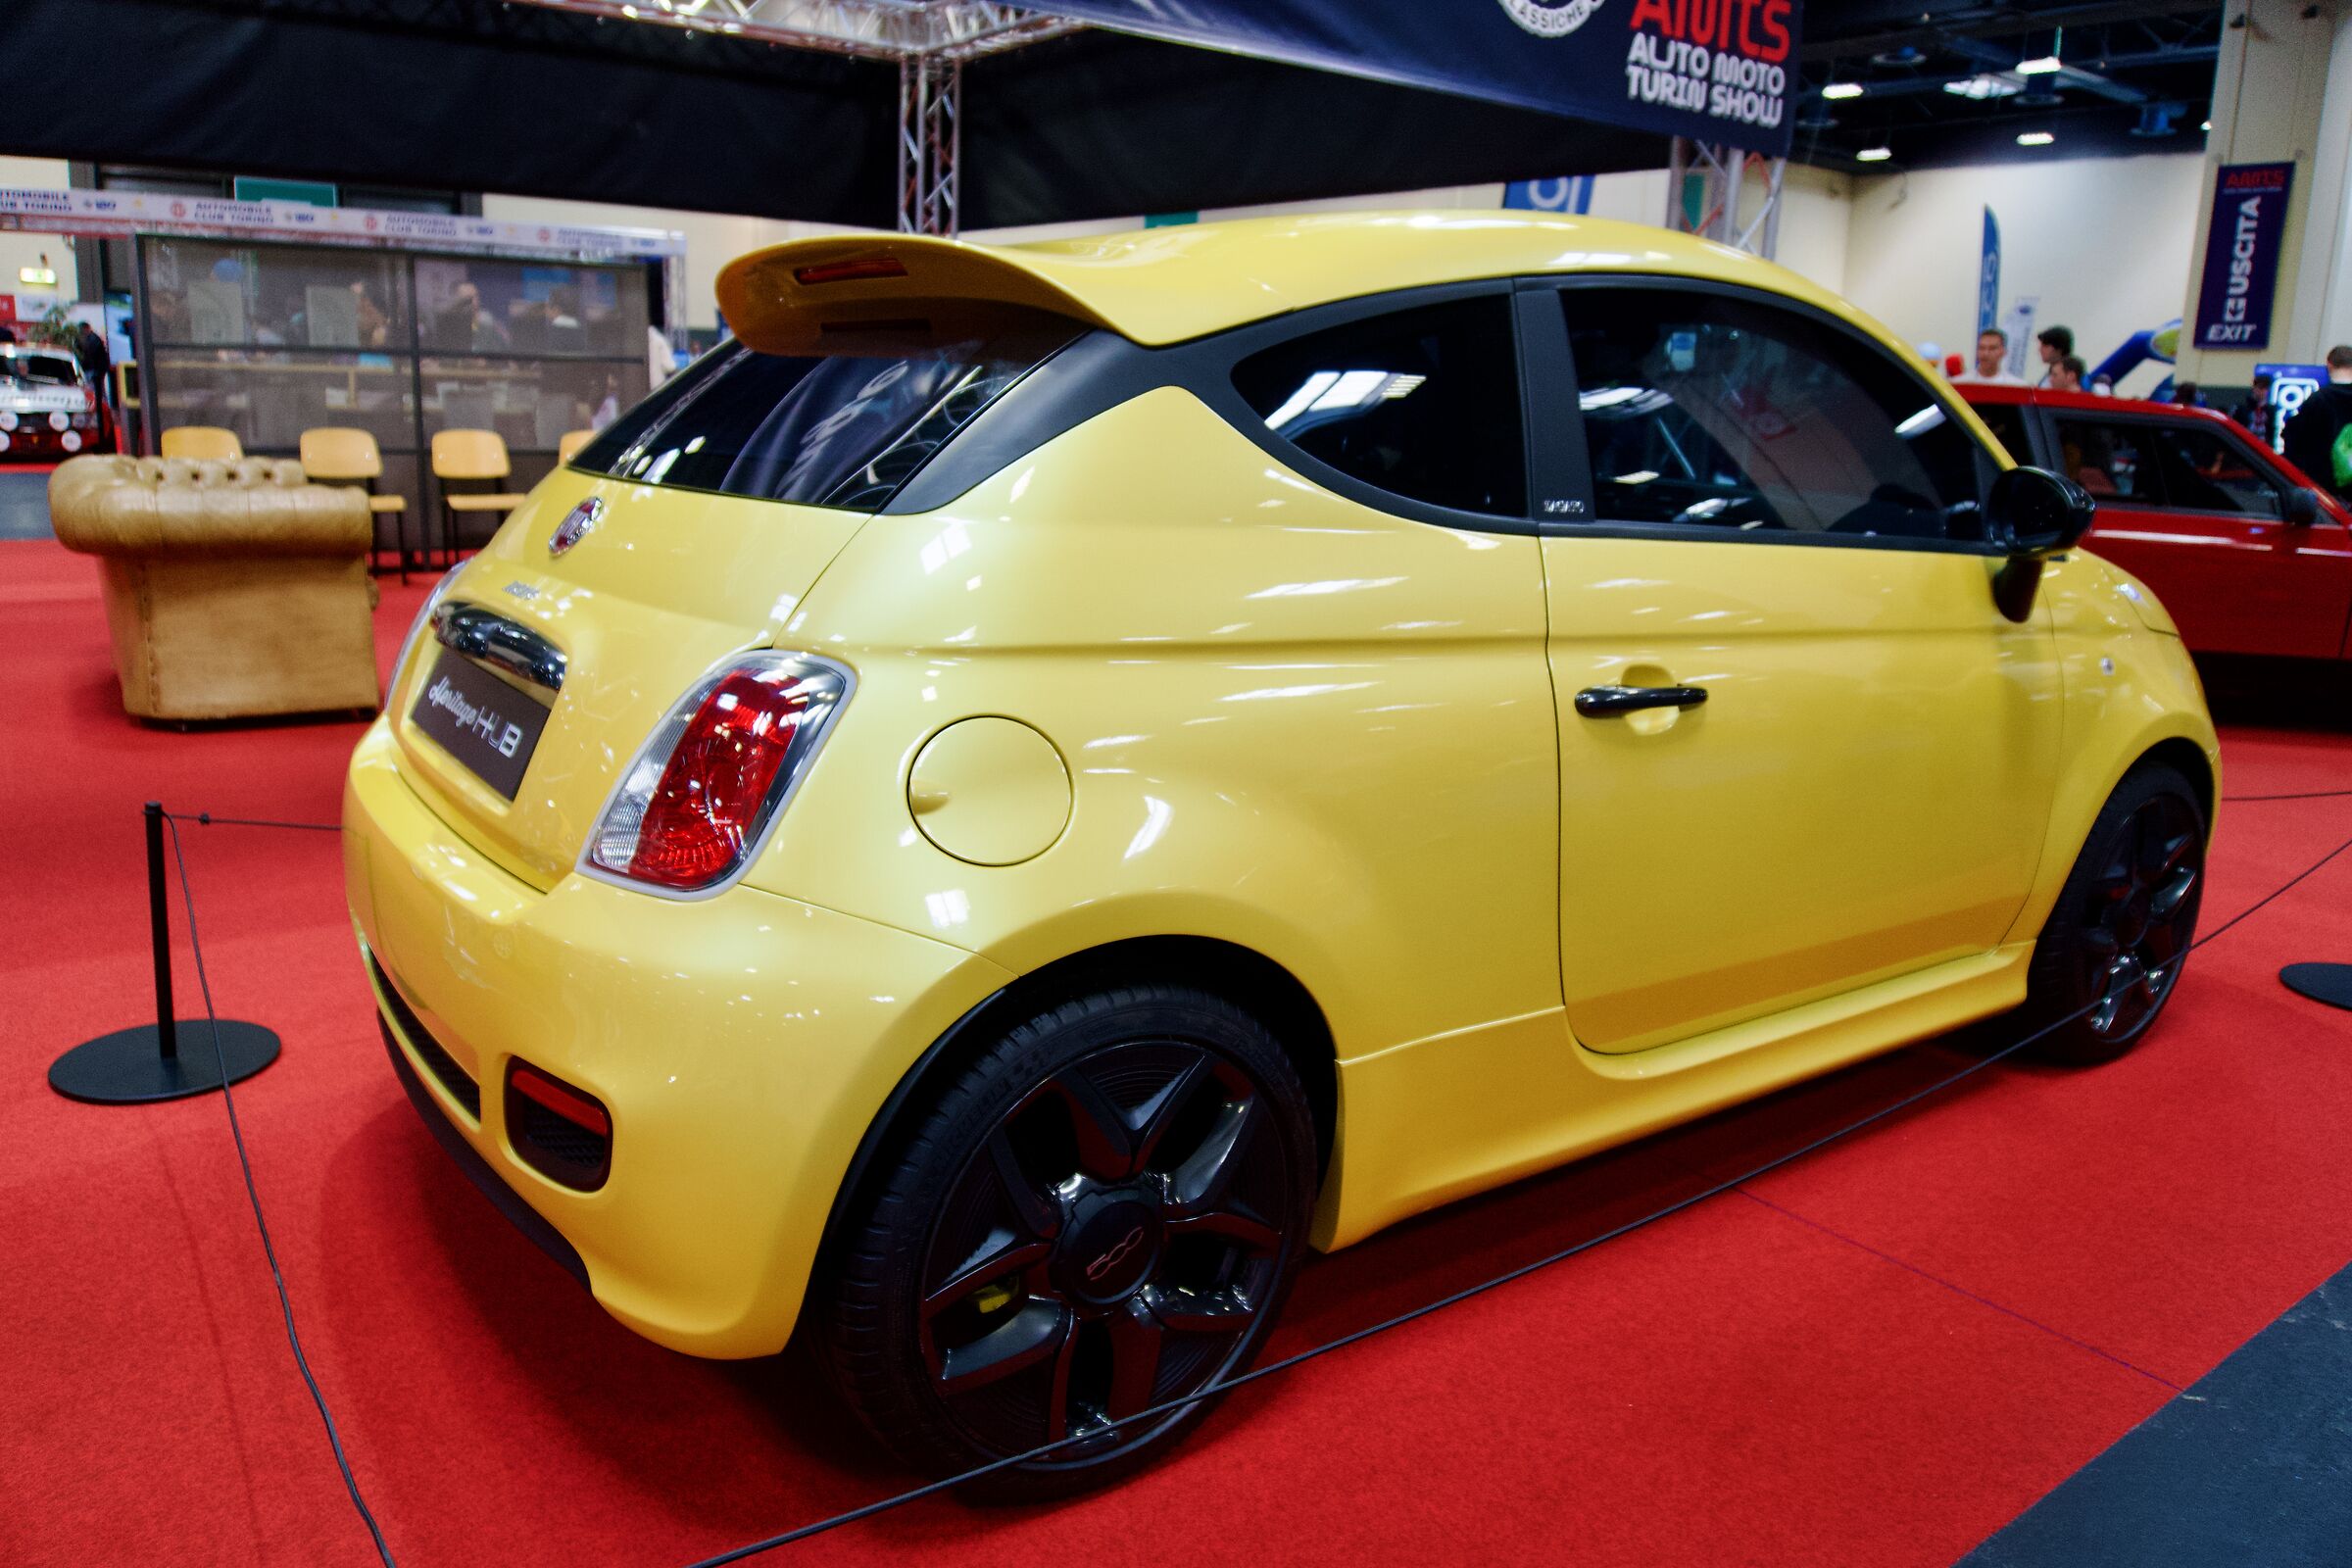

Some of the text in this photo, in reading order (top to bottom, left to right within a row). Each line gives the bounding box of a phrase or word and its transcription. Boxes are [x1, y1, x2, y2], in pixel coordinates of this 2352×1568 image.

[1627, 64, 1784, 128] TURIN SHOW
[1628, 31, 1786, 97] AUTO MOTO
[2228, 195, 2262, 295] USCITA
[2207, 322, 2256, 342] EXIT
[428, 675, 523, 759] Heritage HUB
[1086, 1226, 1145, 1281] 500
